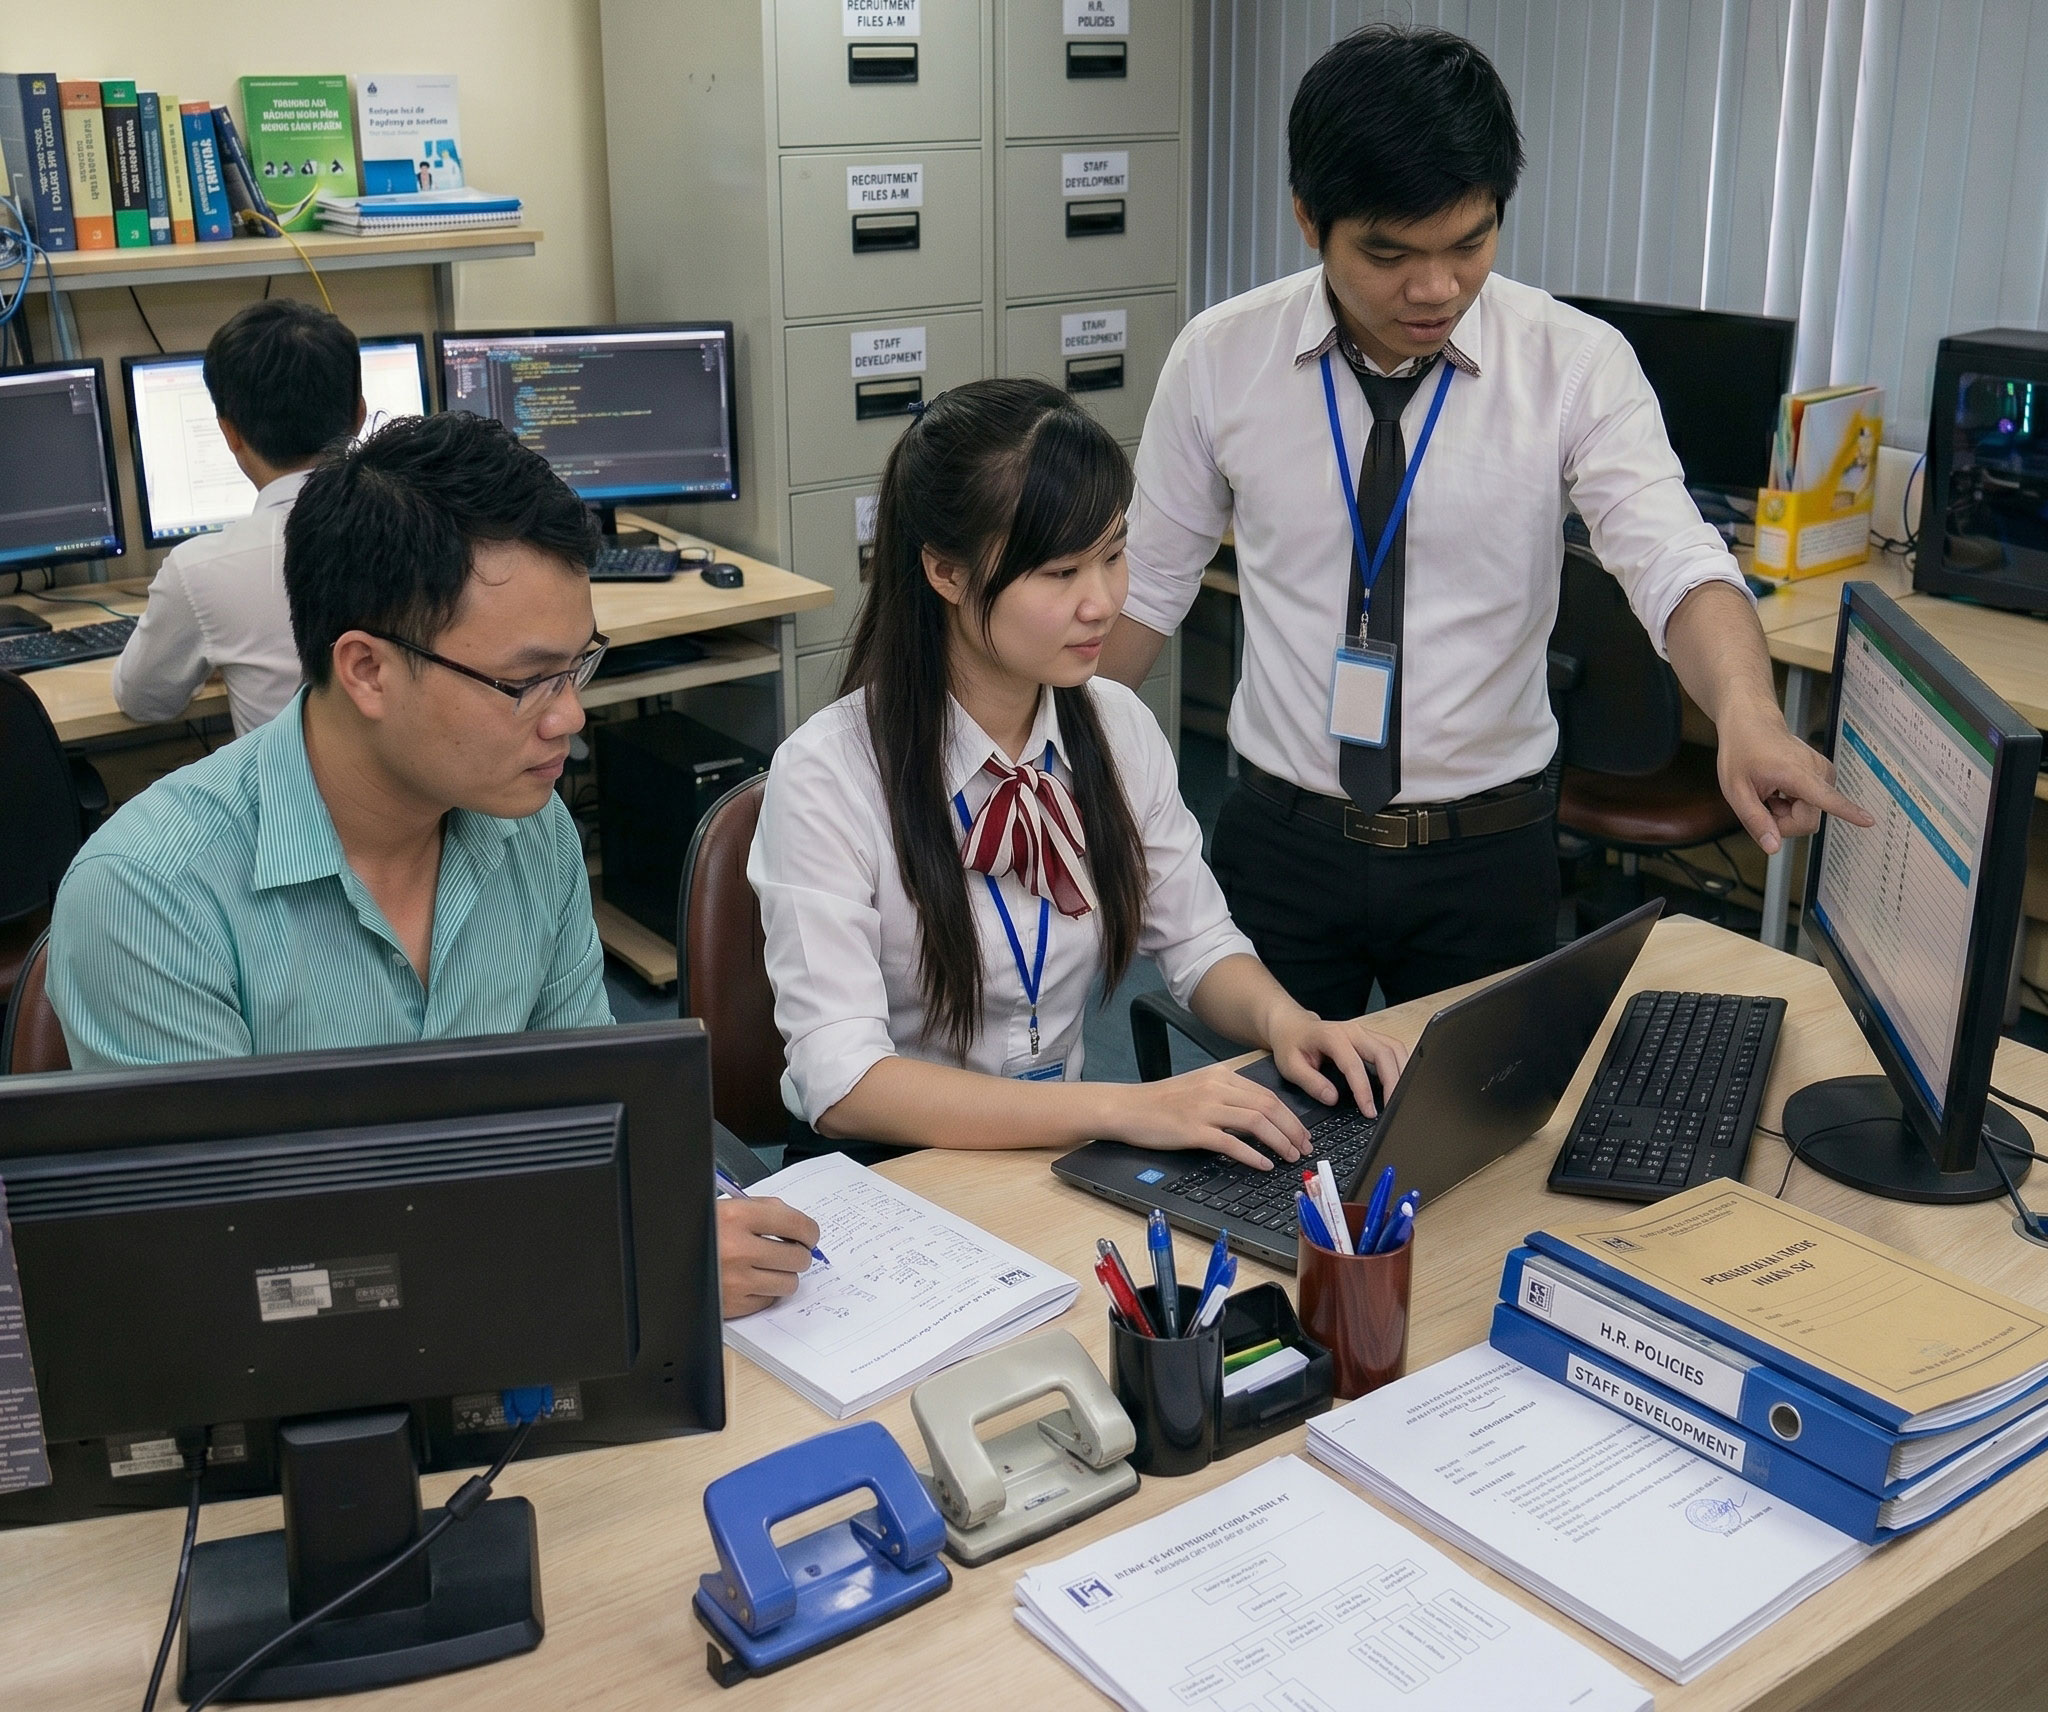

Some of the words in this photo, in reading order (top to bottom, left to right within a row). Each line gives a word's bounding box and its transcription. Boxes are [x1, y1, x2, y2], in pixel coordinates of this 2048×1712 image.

[847, 0, 915, 10] RECRUITMENT
[857, 16, 883, 27] FILES
[887, 16, 905, 26] A-M
[1083, 161, 1109, 172] STAFF
[852, 172, 918, 186] RECRUITMENT
[862, 189, 888, 201] FILES
[891, 188, 909, 199] A-M
[873, 338, 901, 350] STAFF
[855, 351, 922, 367] DEVELOPMENT
[1600, 1322, 1630, 1349] H.R.
[1634, 1339, 1704, 1386] POLICIES
[1575, 1366, 1620, 1398] STAFF
[1624, 1391, 1738, 1461] DEVELOPMENT
